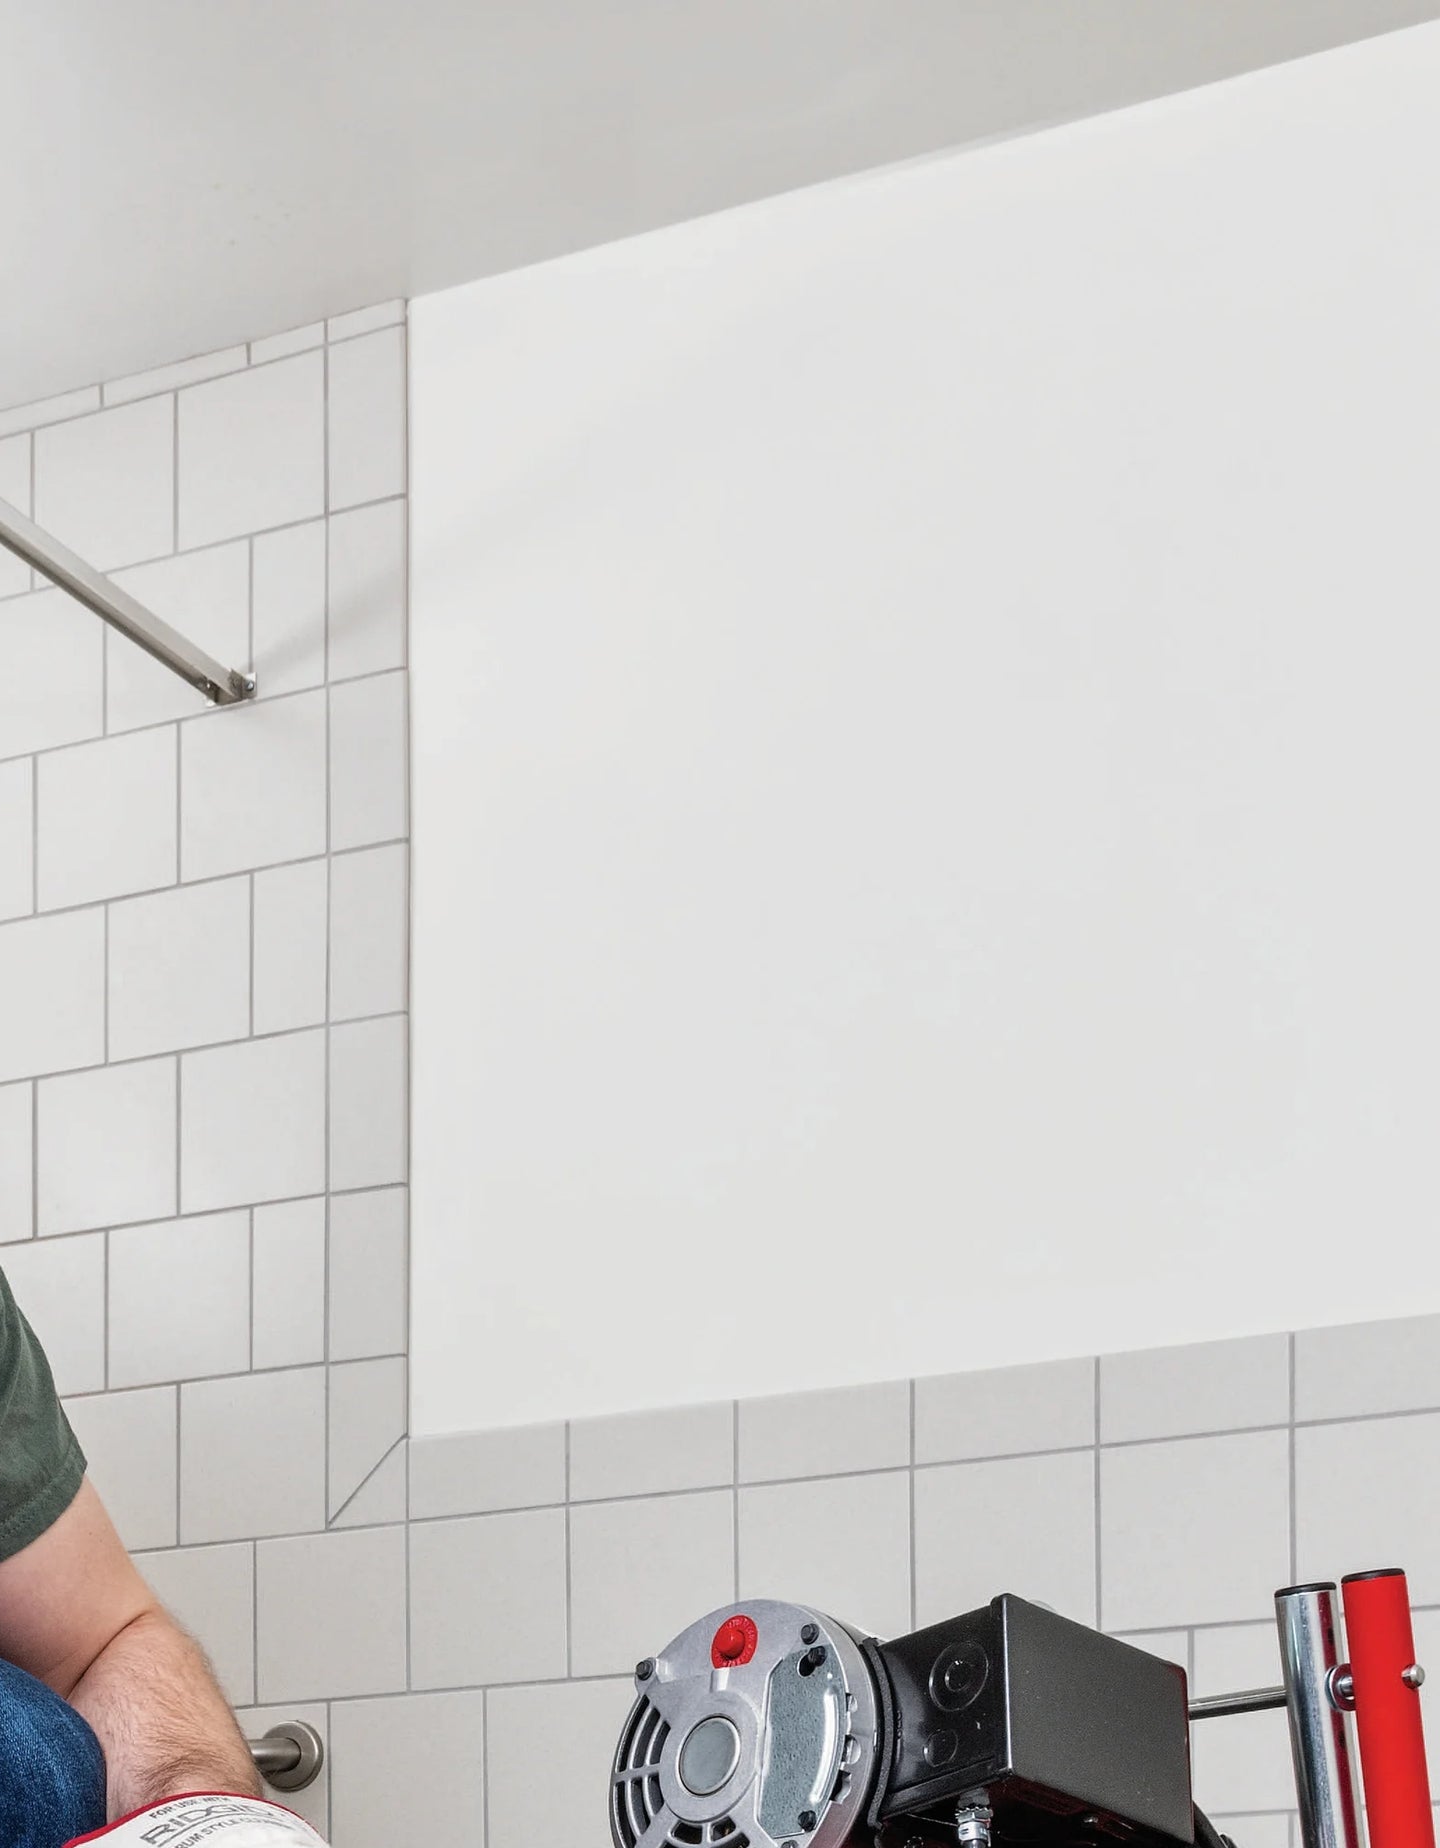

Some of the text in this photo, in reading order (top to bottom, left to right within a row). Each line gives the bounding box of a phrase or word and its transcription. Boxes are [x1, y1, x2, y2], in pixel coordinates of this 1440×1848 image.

[149, 1806, 176, 1819] FOR
[140, 1804, 274, 1845] RIDGID
[205, 1819, 239, 1835] STYLE
